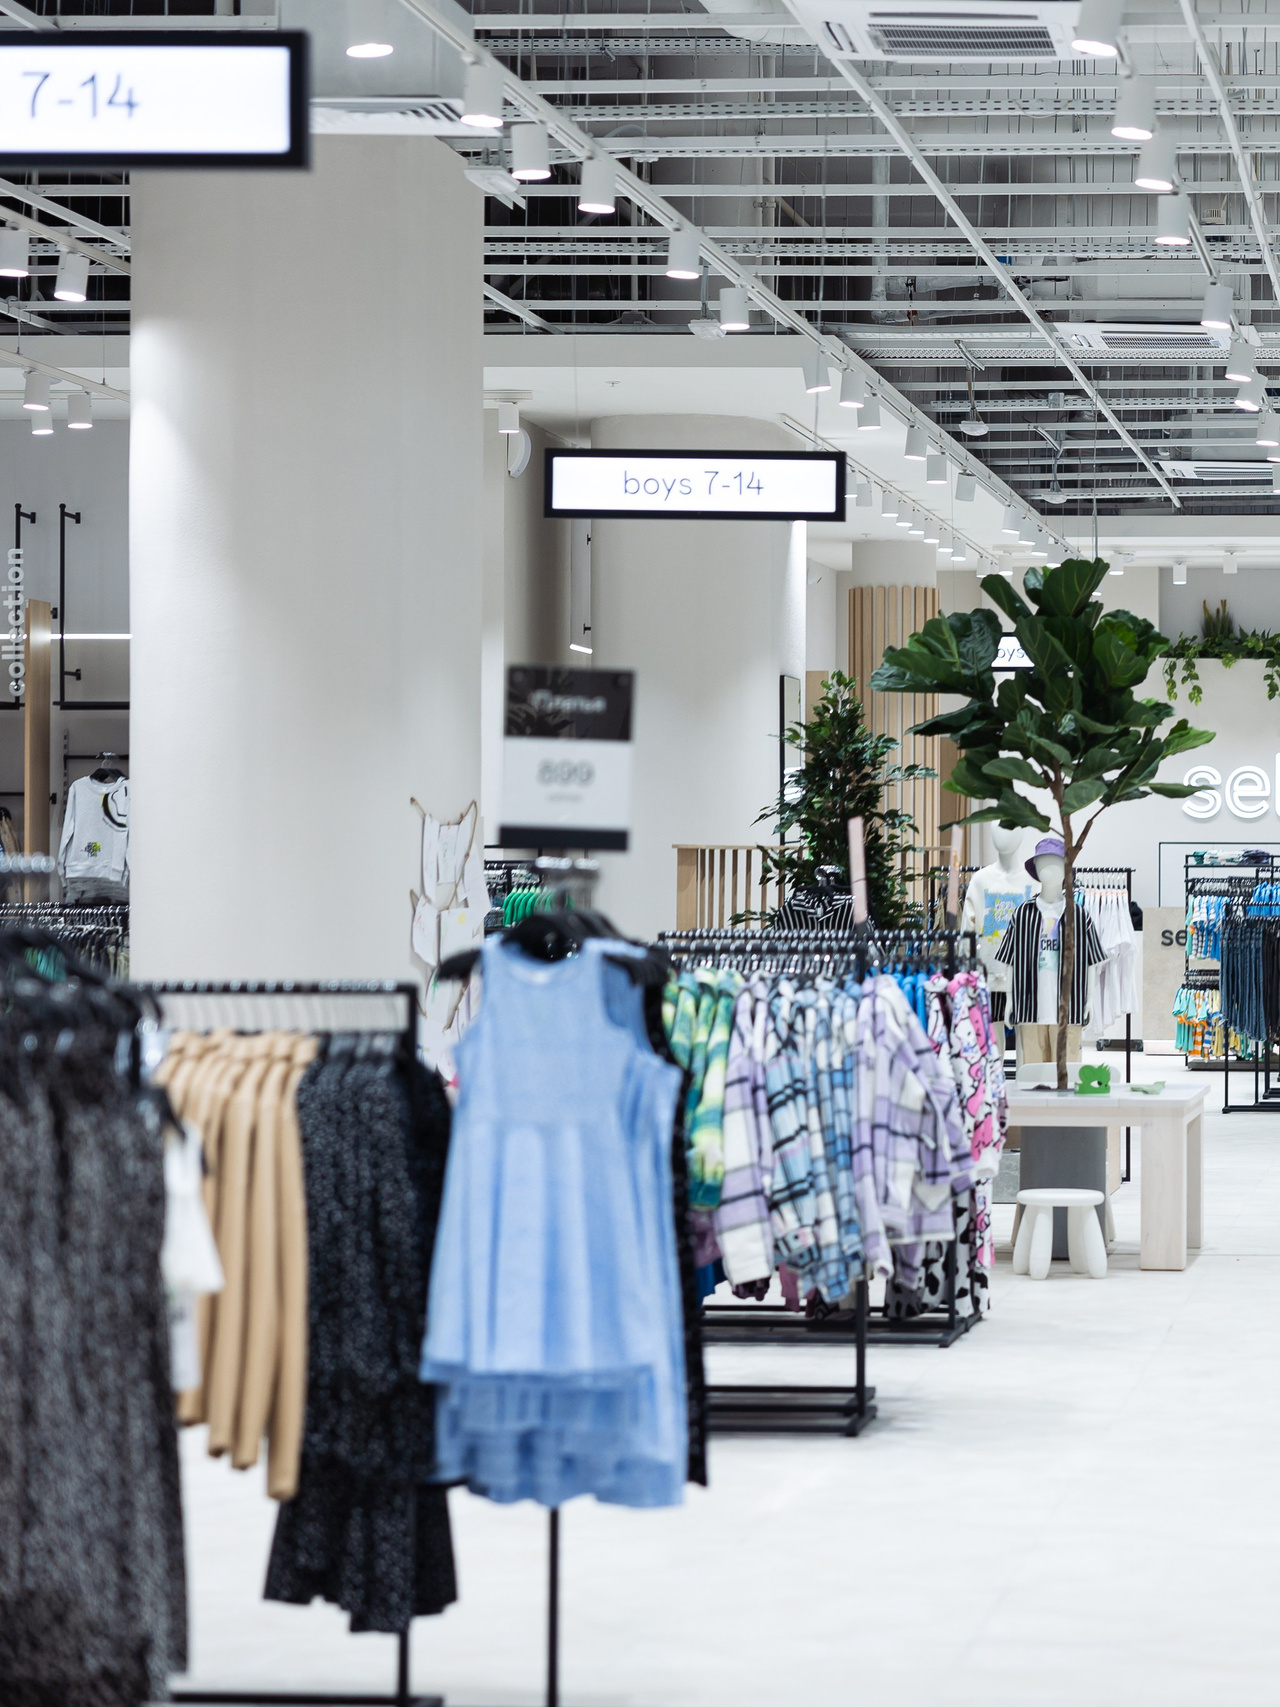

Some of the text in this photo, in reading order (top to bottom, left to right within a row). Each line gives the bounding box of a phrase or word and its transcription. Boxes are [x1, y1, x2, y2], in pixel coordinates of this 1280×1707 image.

[21, 71, 140, 119] 7-14
[623, 470, 765, 502] boys 7-14
[1, 547, 26, 697] collection
[997, 647, 1026, 662] oys
[1161, 929, 1187, 947] se
